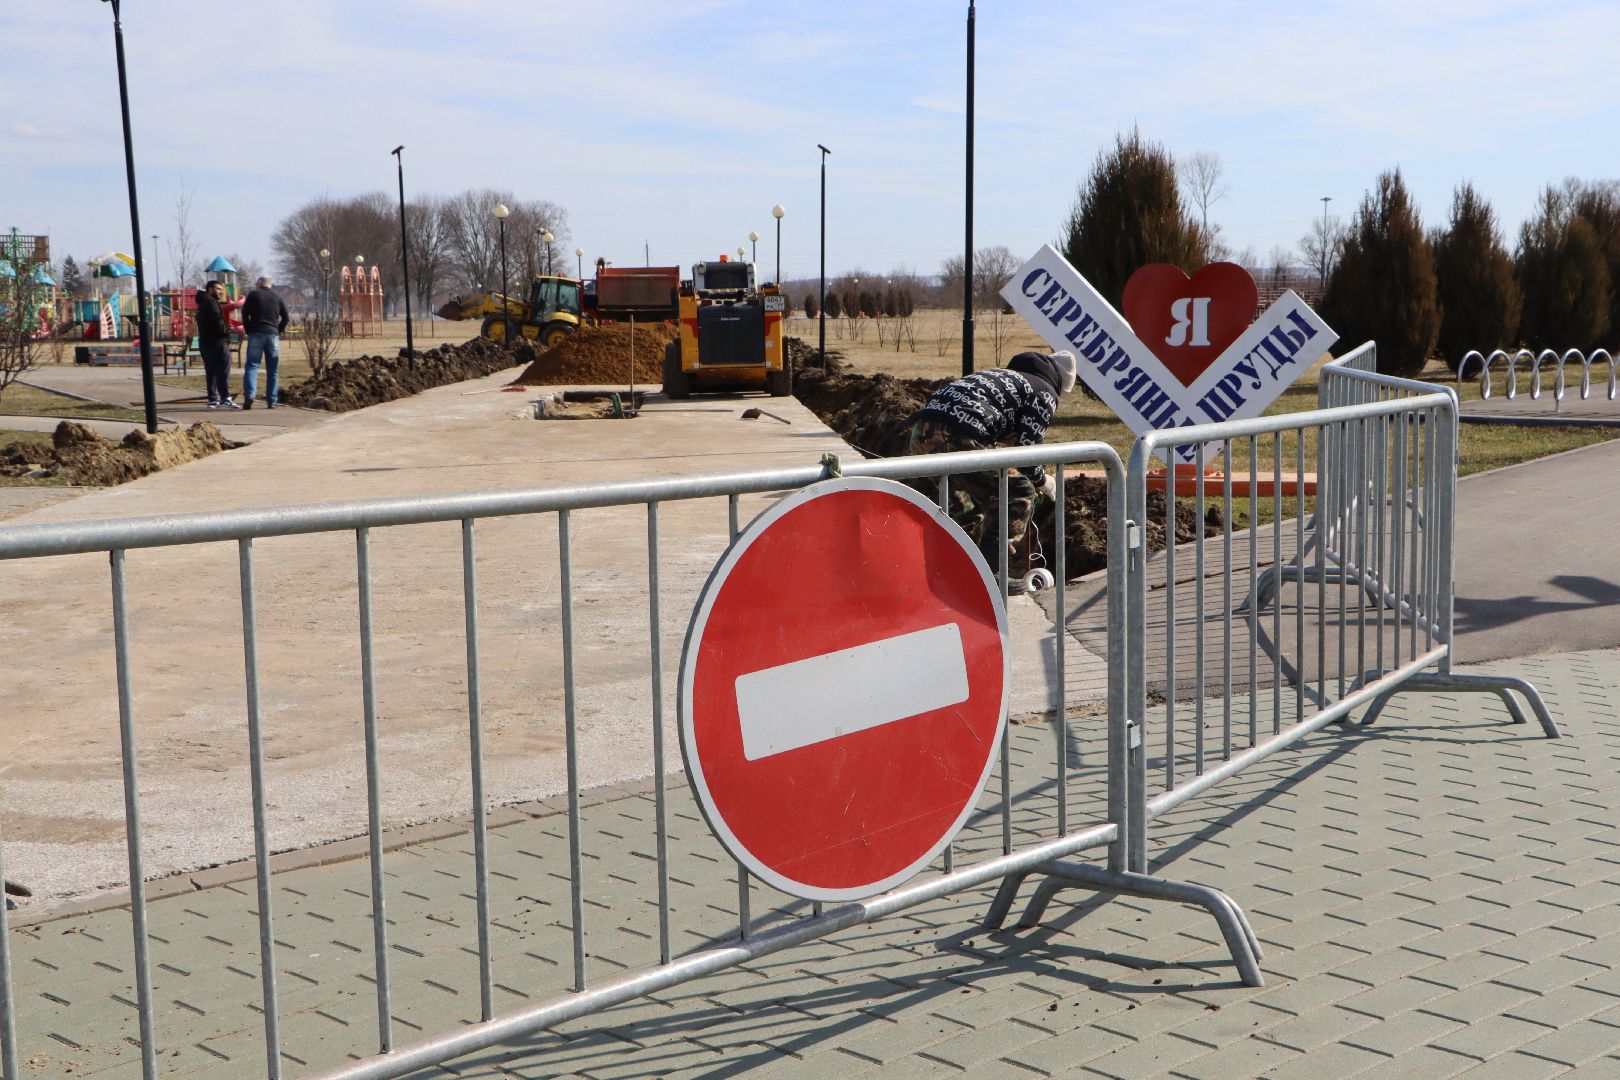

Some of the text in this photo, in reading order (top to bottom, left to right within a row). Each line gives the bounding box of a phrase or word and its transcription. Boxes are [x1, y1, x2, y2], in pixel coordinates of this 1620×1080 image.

[1165, 297, 1212, 347] Я
[1196, 308, 1319, 423] ПРУДЫ
[925, 399, 951, 413] Black
